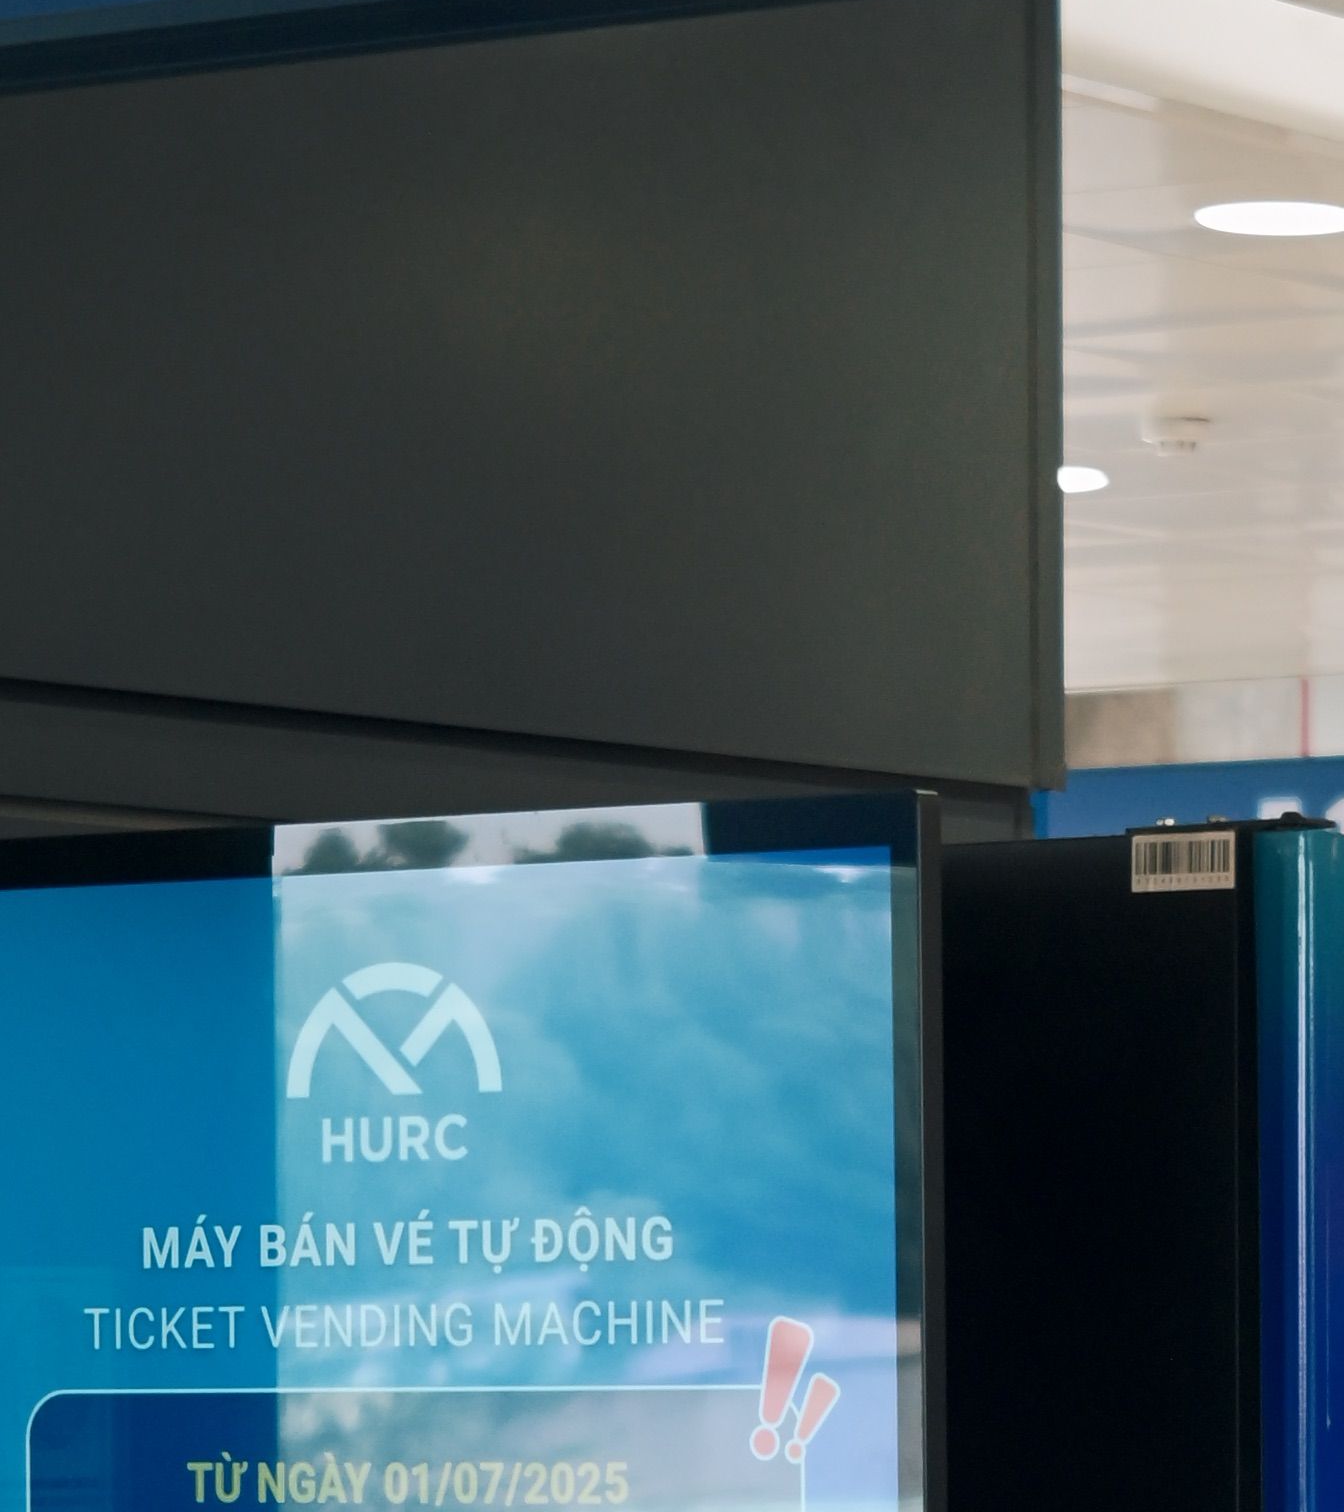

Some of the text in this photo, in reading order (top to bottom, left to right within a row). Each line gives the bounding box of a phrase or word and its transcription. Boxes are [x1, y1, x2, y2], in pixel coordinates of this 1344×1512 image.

[319, 1112, 470, 1164] HURC
[141, 1205, 674, 1275] MÁY BÁN VÉ TỰ ĐỘNG
[83, 1298, 726, 1352] TICKET VENDING MACHINE
[187, 1452, 630, 1506] TỪ NGÀY 01/07/2025
